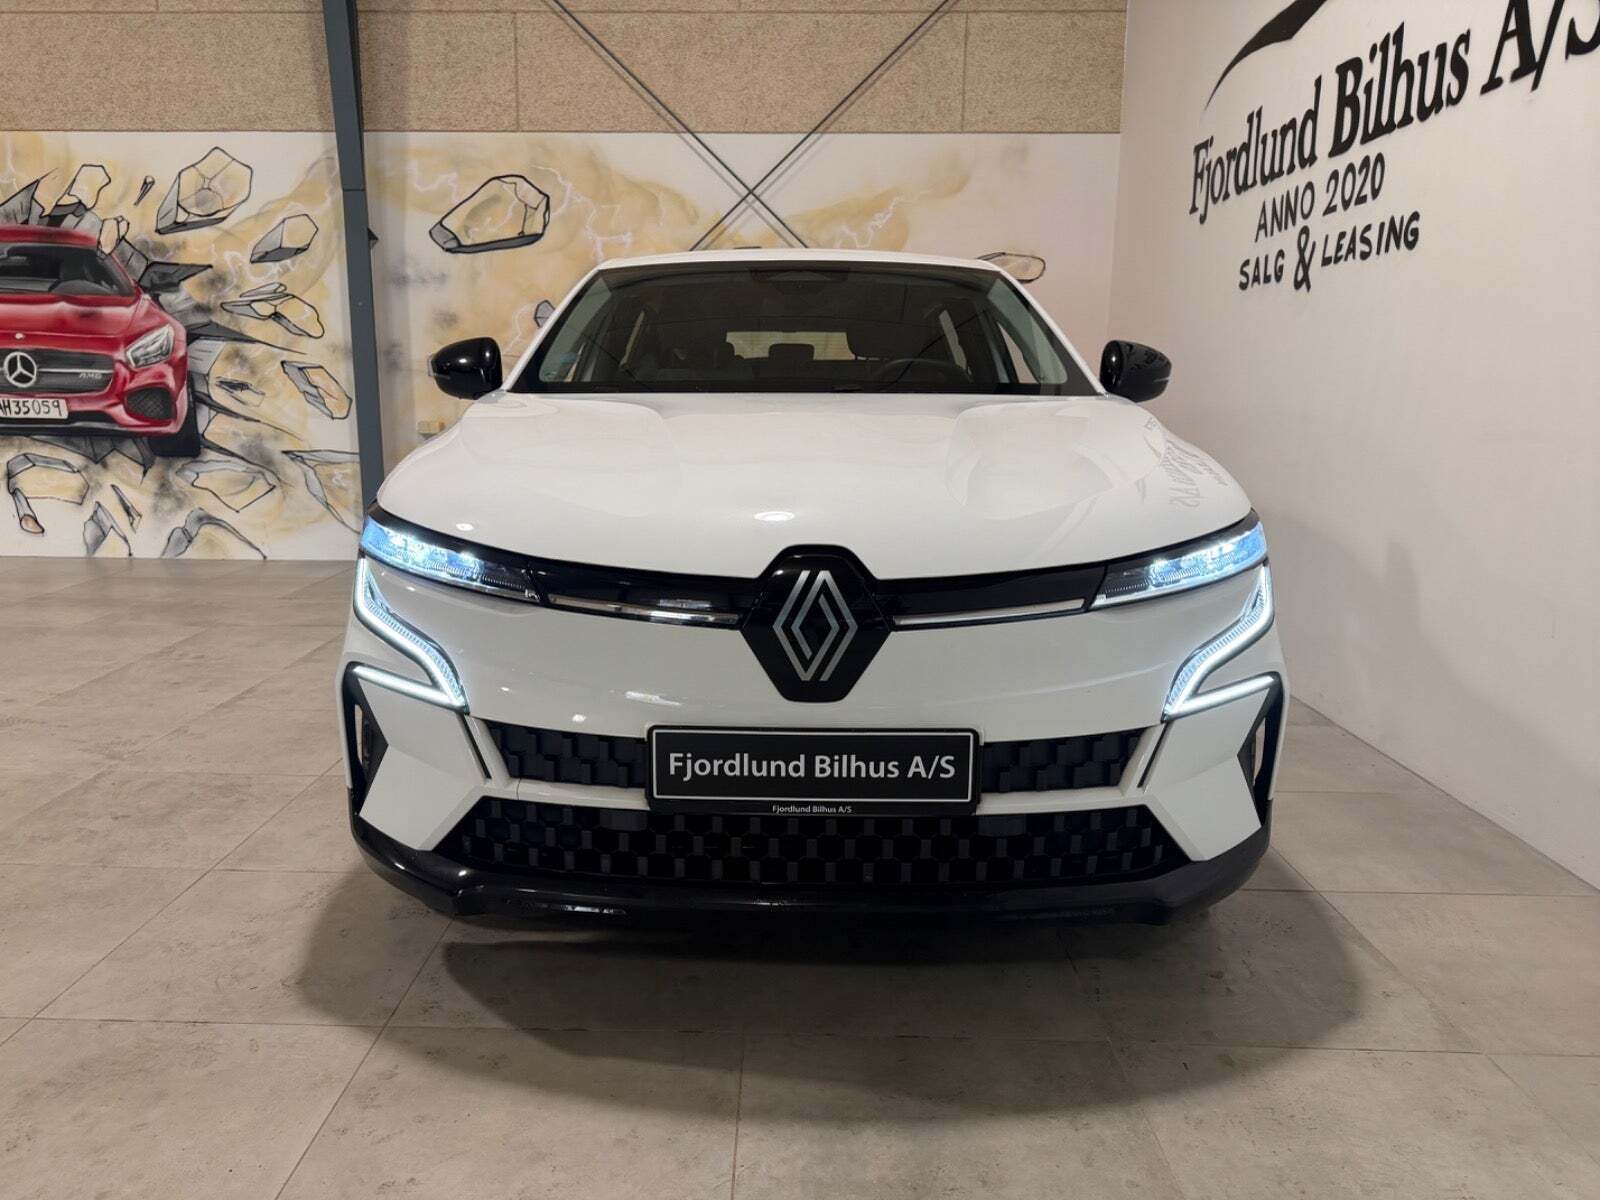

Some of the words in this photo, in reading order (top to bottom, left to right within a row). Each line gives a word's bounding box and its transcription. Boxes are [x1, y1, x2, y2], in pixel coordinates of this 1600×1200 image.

[1189, 75, 1322, 224] Fjordlund
[1328, 21, 1470, 158] Bilhus
[1255, 181, 1315, 243] ANNO
[1322, 152, 1385, 216] 2020
[1239, 248, 1285, 290] SALG
[1293, 225, 1316, 292] &
[1321, 211, 1420, 266] LEASING
[669, 753, 805, 781] Fjordlund
[814, 755, 899, 778] Bilhus
[907, 755, 956, 779] A/S
[772, 804, 811, 814] Fjordlund
[812, 805, 837, 813] Bilhus
[838, 805, 853, 814] A/S
